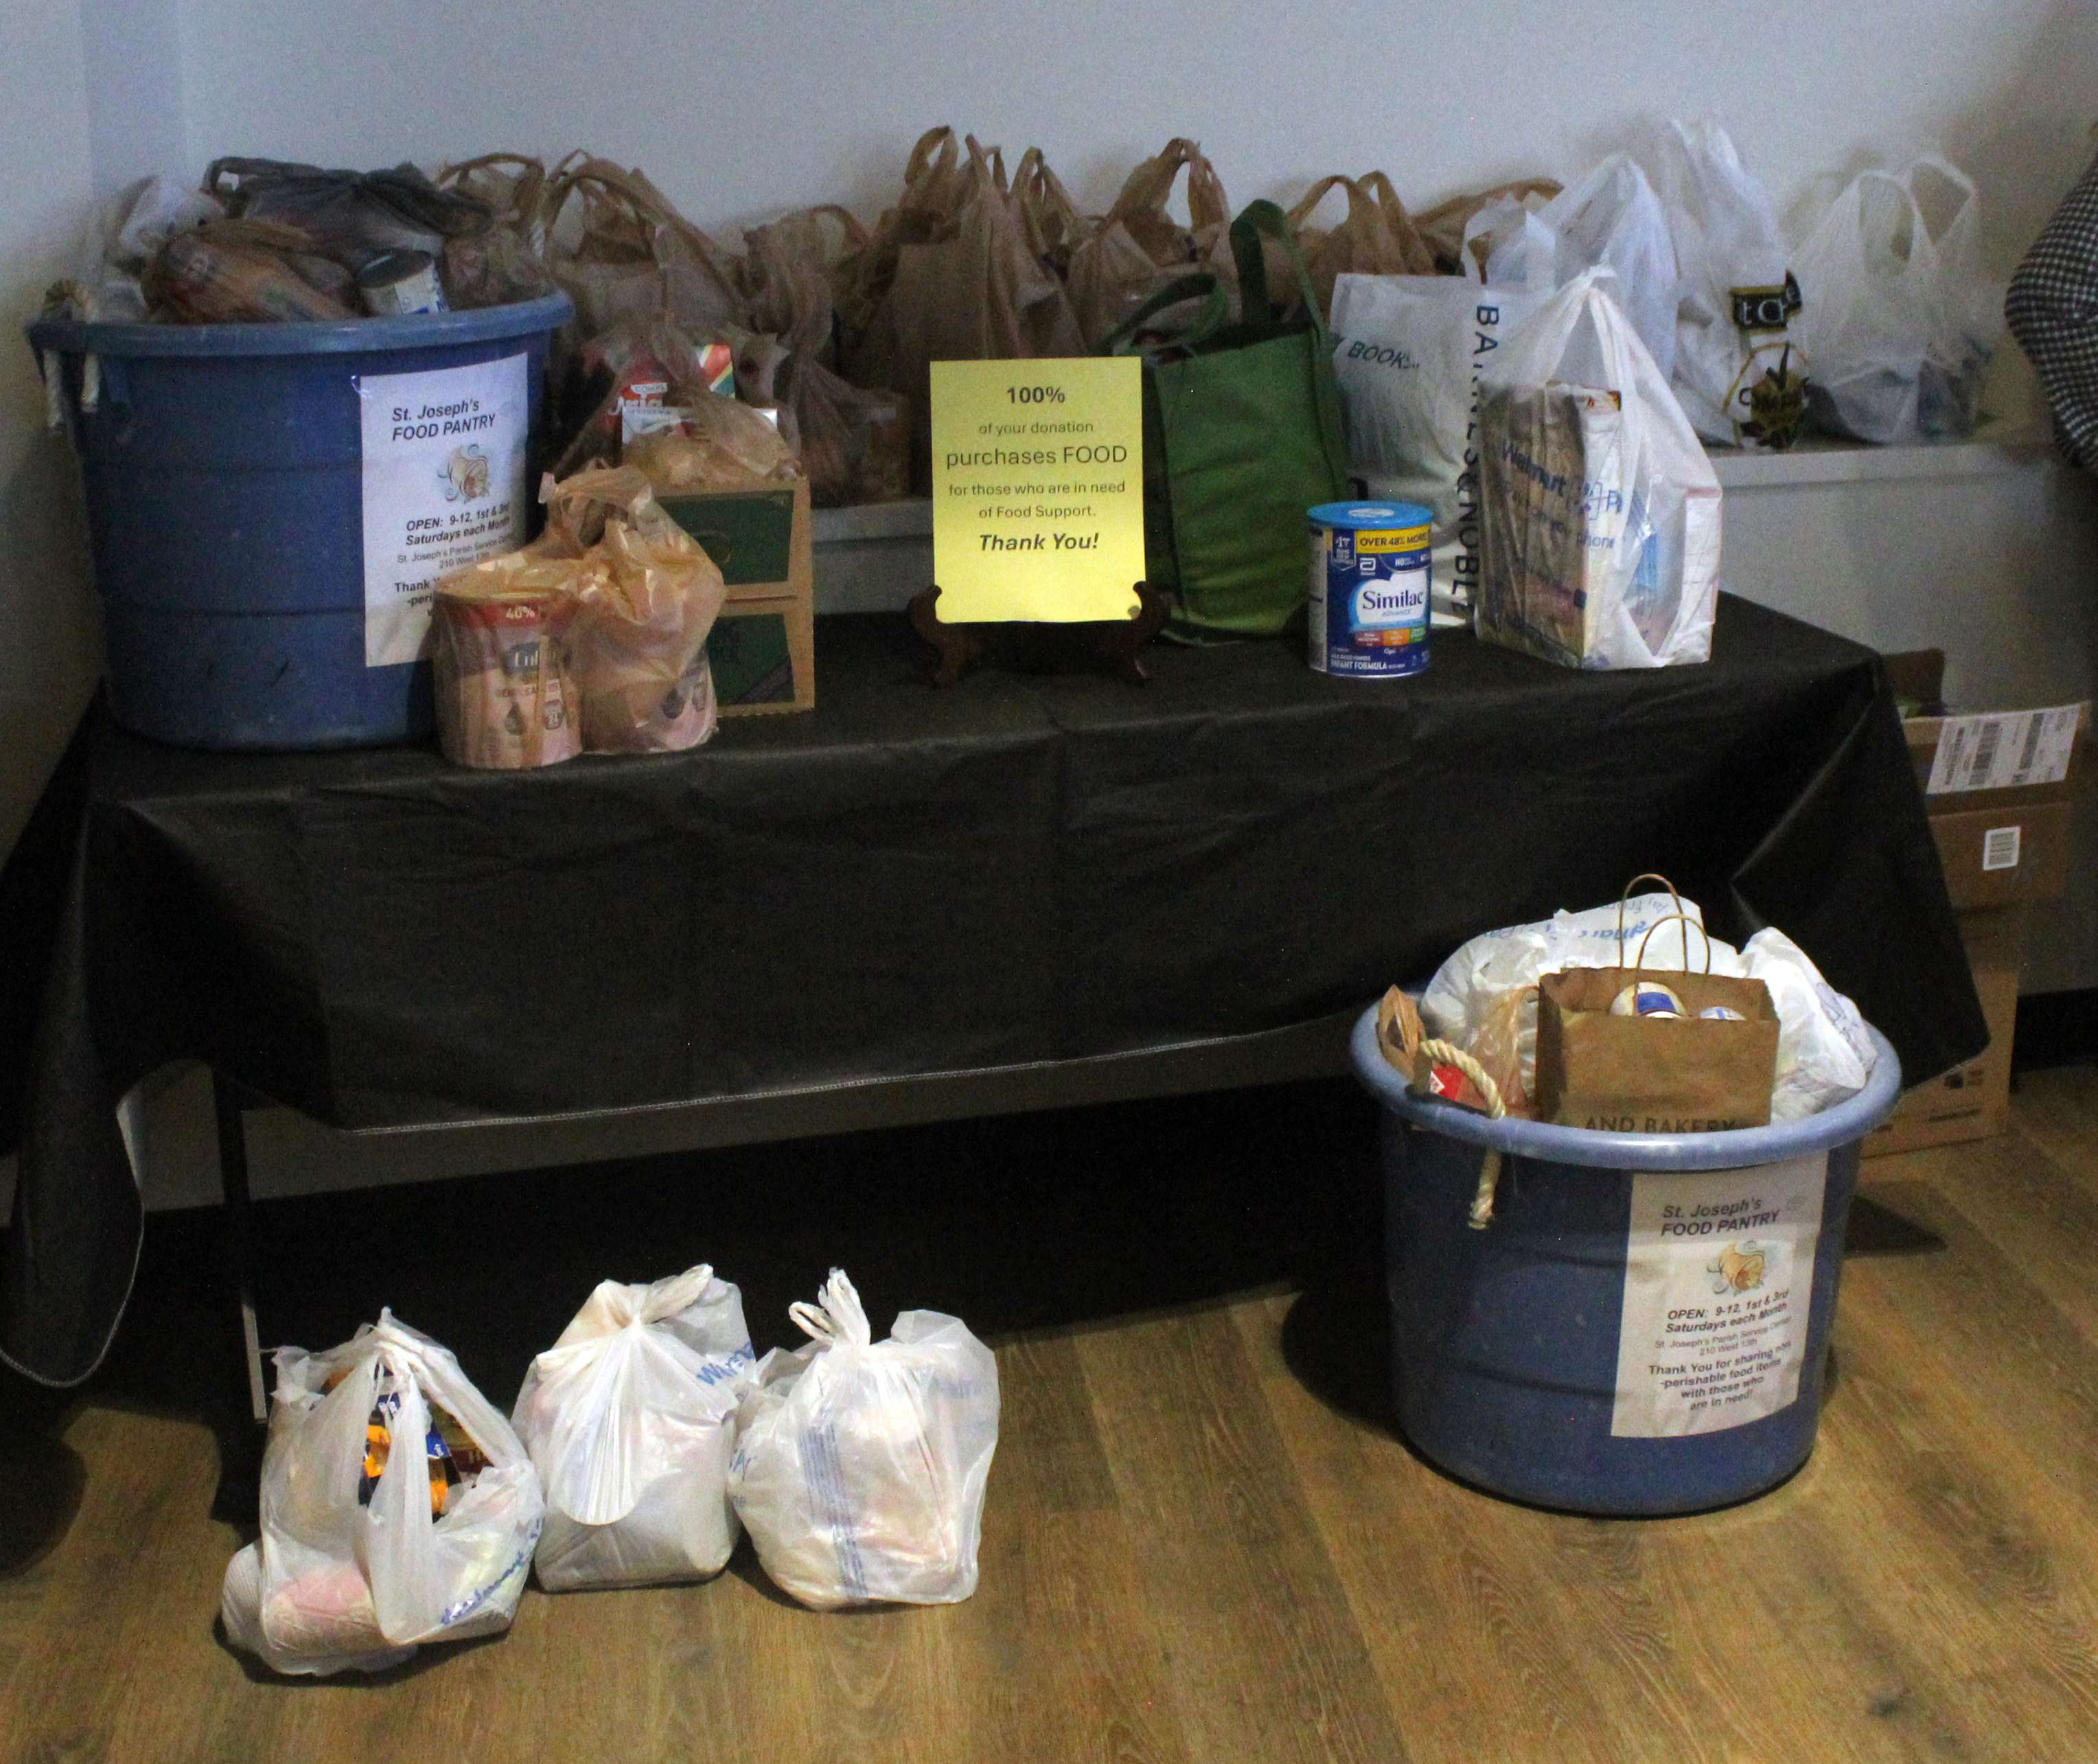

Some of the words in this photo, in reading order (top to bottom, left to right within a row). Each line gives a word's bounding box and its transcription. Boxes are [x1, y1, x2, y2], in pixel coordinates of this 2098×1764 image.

[1007, 386, 1065, 404] 100%
[393, 408, 411, 422] St.
[417, 399, 479, 420] Joseph's
[393, 424, 439, 441] FOOD
[443, 413, 496, 435] PANTRY
[979, 422, 993, 435] of
[996, 424, 1027, 437] your
[1030, 421, 1094, 434] donation
[947, 448, 1057, 470] purchases
[1064, 446, 1127, 463] FOOD
[949, 484, 968, 496] for
[972, 483, 1011, 495] those
[1015, 483, 1045, 494] who
[1048, 483, 1070, 494] are
[1074, 483, 1086, 493] in
[1090, 481, 1126, 493] need
[979, 506, 993, 518] of
[997, 506, 1031, 518] Food
[1035, 505, 1096, 519] Support.
[406, 518, 443, 531] OPEN:
[406, 530, 460, 546] Saturdays
[463, 525, 485, 536] each
[980, 534, 1046, 551] Thank
[1053, 532, 1099, 550] You!
[1360, 538, 1387, 546] OVER
[395, 580, 430, 592] Thank
[1362, 590, 1423, 610] Similac
[506, 606, 535, 619] 40%
[1354, 661, 1387, 670] FORMULA
[1587, 1116, 1635, 1130] AND
[1664, 1206, 1683, 1217] St.
[1691, 1198, 1762, 1217] Joseph's
[1661, 1222, 1712, 1236] FOOD
[1718, 1209, 1780, 1233] PANTRY
[1668, 1309, 1707, 1320] OPEN:
[1747, 1300, 1761, 1309] 1st
[1665, 1320, 1726, 1333] Saturdays
[1731, 1314, 1755, 1326] each
[1648, 1365, 1686, 1375] Thank
[1691, 1363, 1712, 1372] You
[1716, 1359, 1731, 1369] for
[1735, 1349, 1773, 1365] sharing
[1660, 1372, 1726, 1389] -perishable
[1729, 1365, 1753, 1377] food
[1681, 1388, 1705, 1398] with
[1709, 1383, 1740, 1395] those
[1743, 1375, 1764, 1387] who
[1690, 1400, 1707, 1410] are
[1711, 1396, 1722, 1406] in
